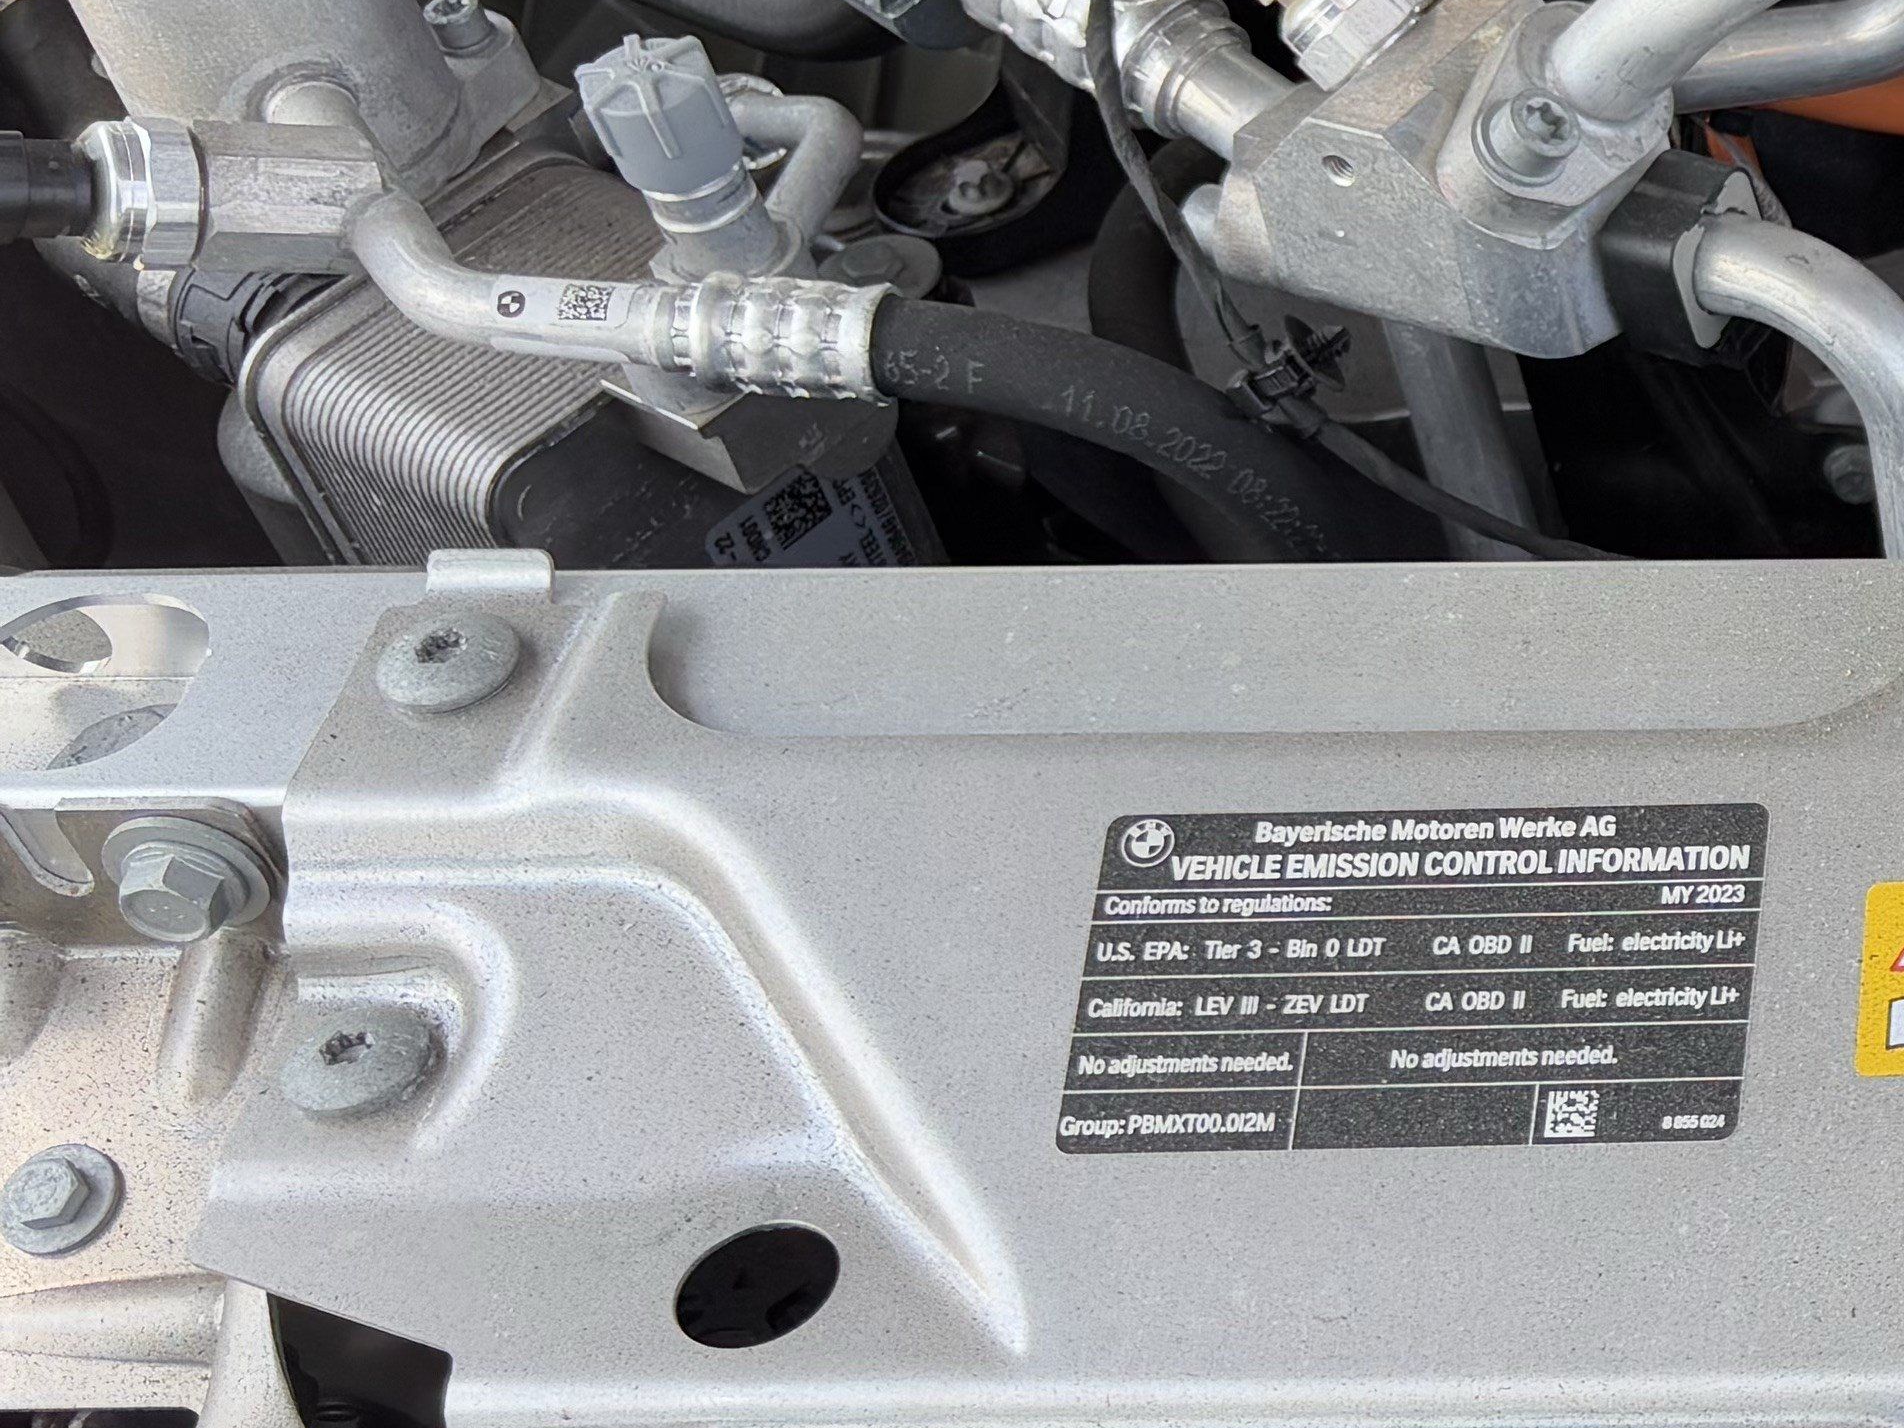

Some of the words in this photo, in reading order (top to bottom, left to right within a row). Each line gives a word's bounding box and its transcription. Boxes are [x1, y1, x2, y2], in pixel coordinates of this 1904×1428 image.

[1255, 821, 1386, 847] Bayerische
[1391, 819, 1494, 841] Motoren
[1499, 816, 1576, 838] Werke
[1580, 815, 1617, 837] AG
[1171, 855, 1282, 881] VEHICLE
[1286, 852, 1420, 880] EMISSION
[1424, 850, 1553, 877] CONTROL
[1558, 845, 1750, 873] INFORMATION
[1104, 896, 1196, 915] Conforms
[1199, 895, 1219, 914] to
[1222, 893, 1332, 917] regulations:
[1661, 885, 1694, 904] MY
[1695, 884, 1746, 903] 2023
[1097, 942, 1136, 962] U.S.
[1143, 941, 1189, 961] EPA:
[1205, 940, 1242, 960] Tier
[1248, 939, 1262, 959] 3
[1287, 939, 1318, 958] Bin
[1347, 937, 1387, 957] LDT
[1432, 936, 1460, 956] CA
[1469, 935, 1512, 955] OBD
[1567, 933, 1614, 954] Fuel:
[1622, 931, 1714, 954] electricity
[1088, 997, 1183, 1019] California:
[1195, 996, 1234, 1017] LEV
[1241, 996, 1259, 1016] III
[1282, 994, 1324, 1015] ZEV
[1330, 993, 1370, 1014] LDT
[1425, 991, 1453, 1012] CA
[1461, 991, 1505, 1010] OBD
[1561, 988, 1607, 1009] Fuel:
[1615, 988, 1708, 1010] electricity
[1078, 1055, 1105, 1075] No
[1108, 1054, 1218, 1077] adjustments
[1221, 1052, 1294, 1072] needed.
[1390, 1049, 1419, 1069] No
[1422, 1048, 1538, 1071] adjustments
[1541, 1045, 1618, 1066] needed.
[1060, 1116, 1126, 1139] Group:
